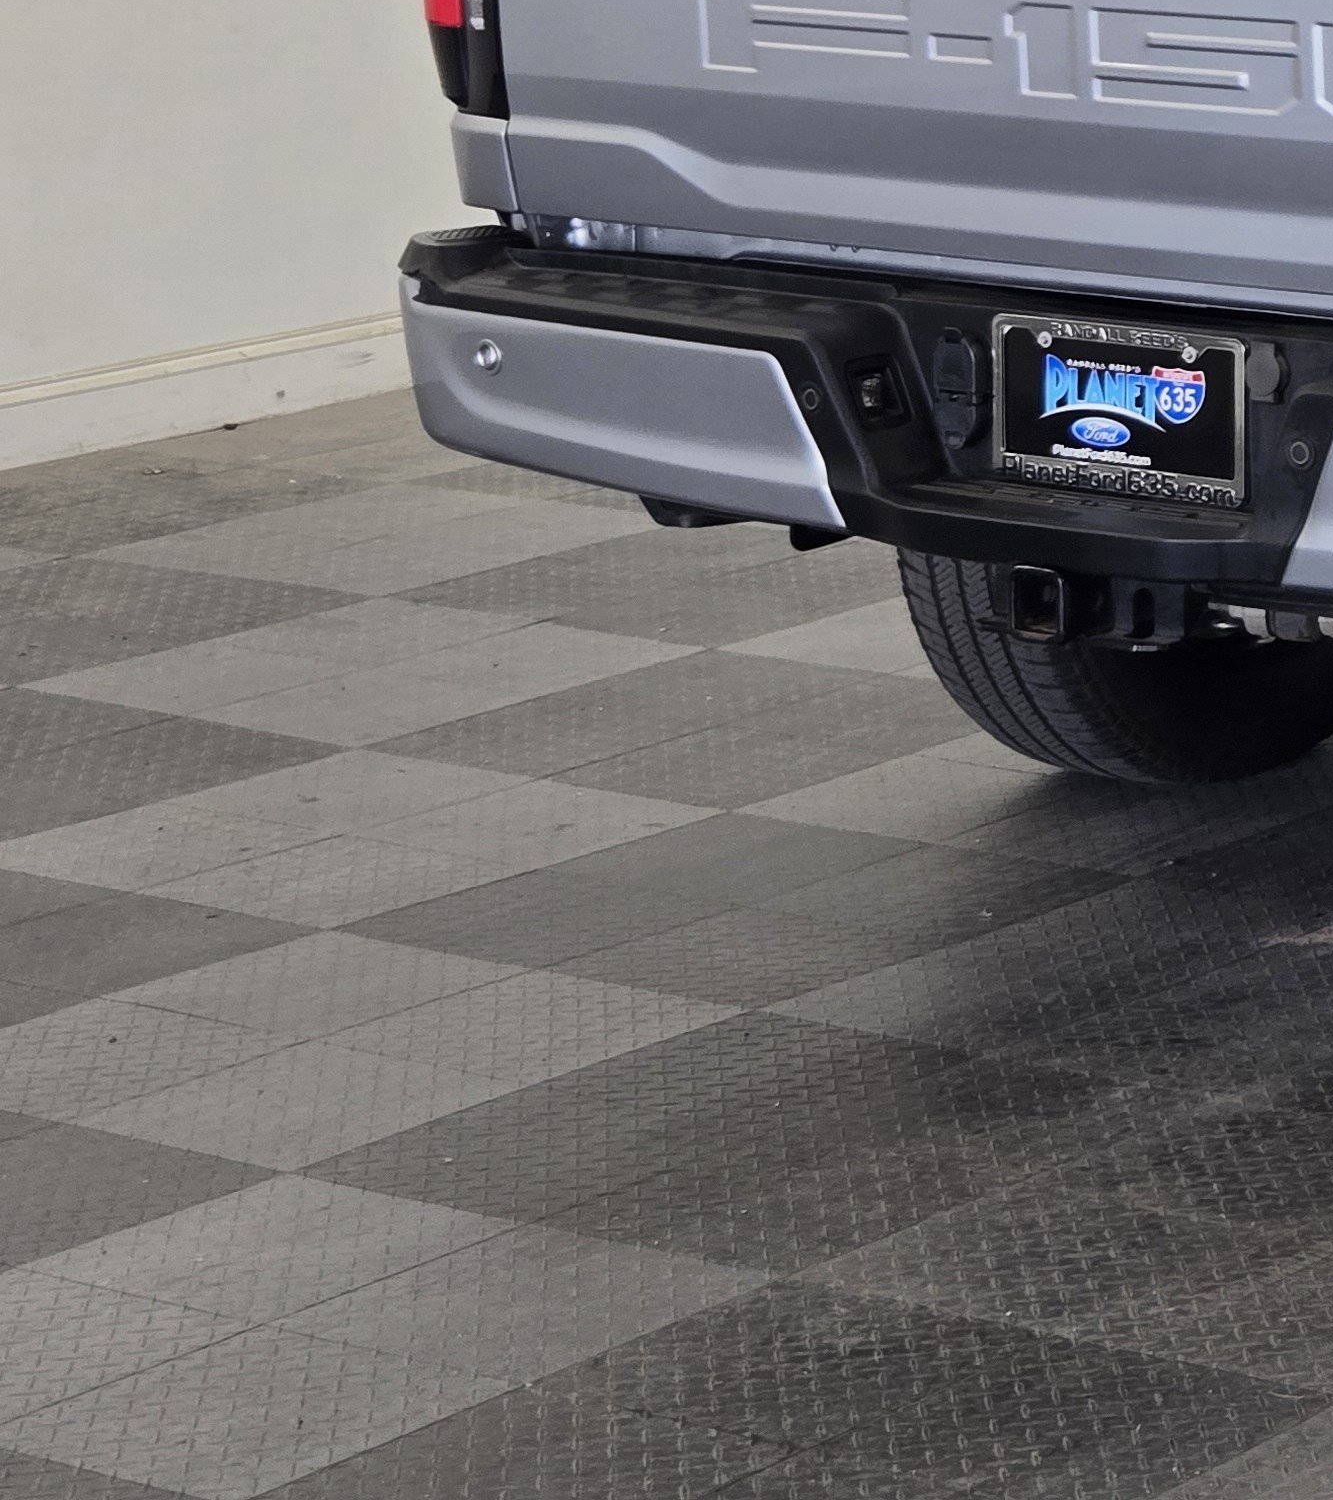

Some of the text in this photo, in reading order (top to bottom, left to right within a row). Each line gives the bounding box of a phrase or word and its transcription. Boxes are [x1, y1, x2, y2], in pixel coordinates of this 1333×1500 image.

[1044, 353, 1196, 424] PLANET 635
[1082, 421, 1120, 444] Ford
[1002, 454, 1239, 505] PlanetFord635.com
